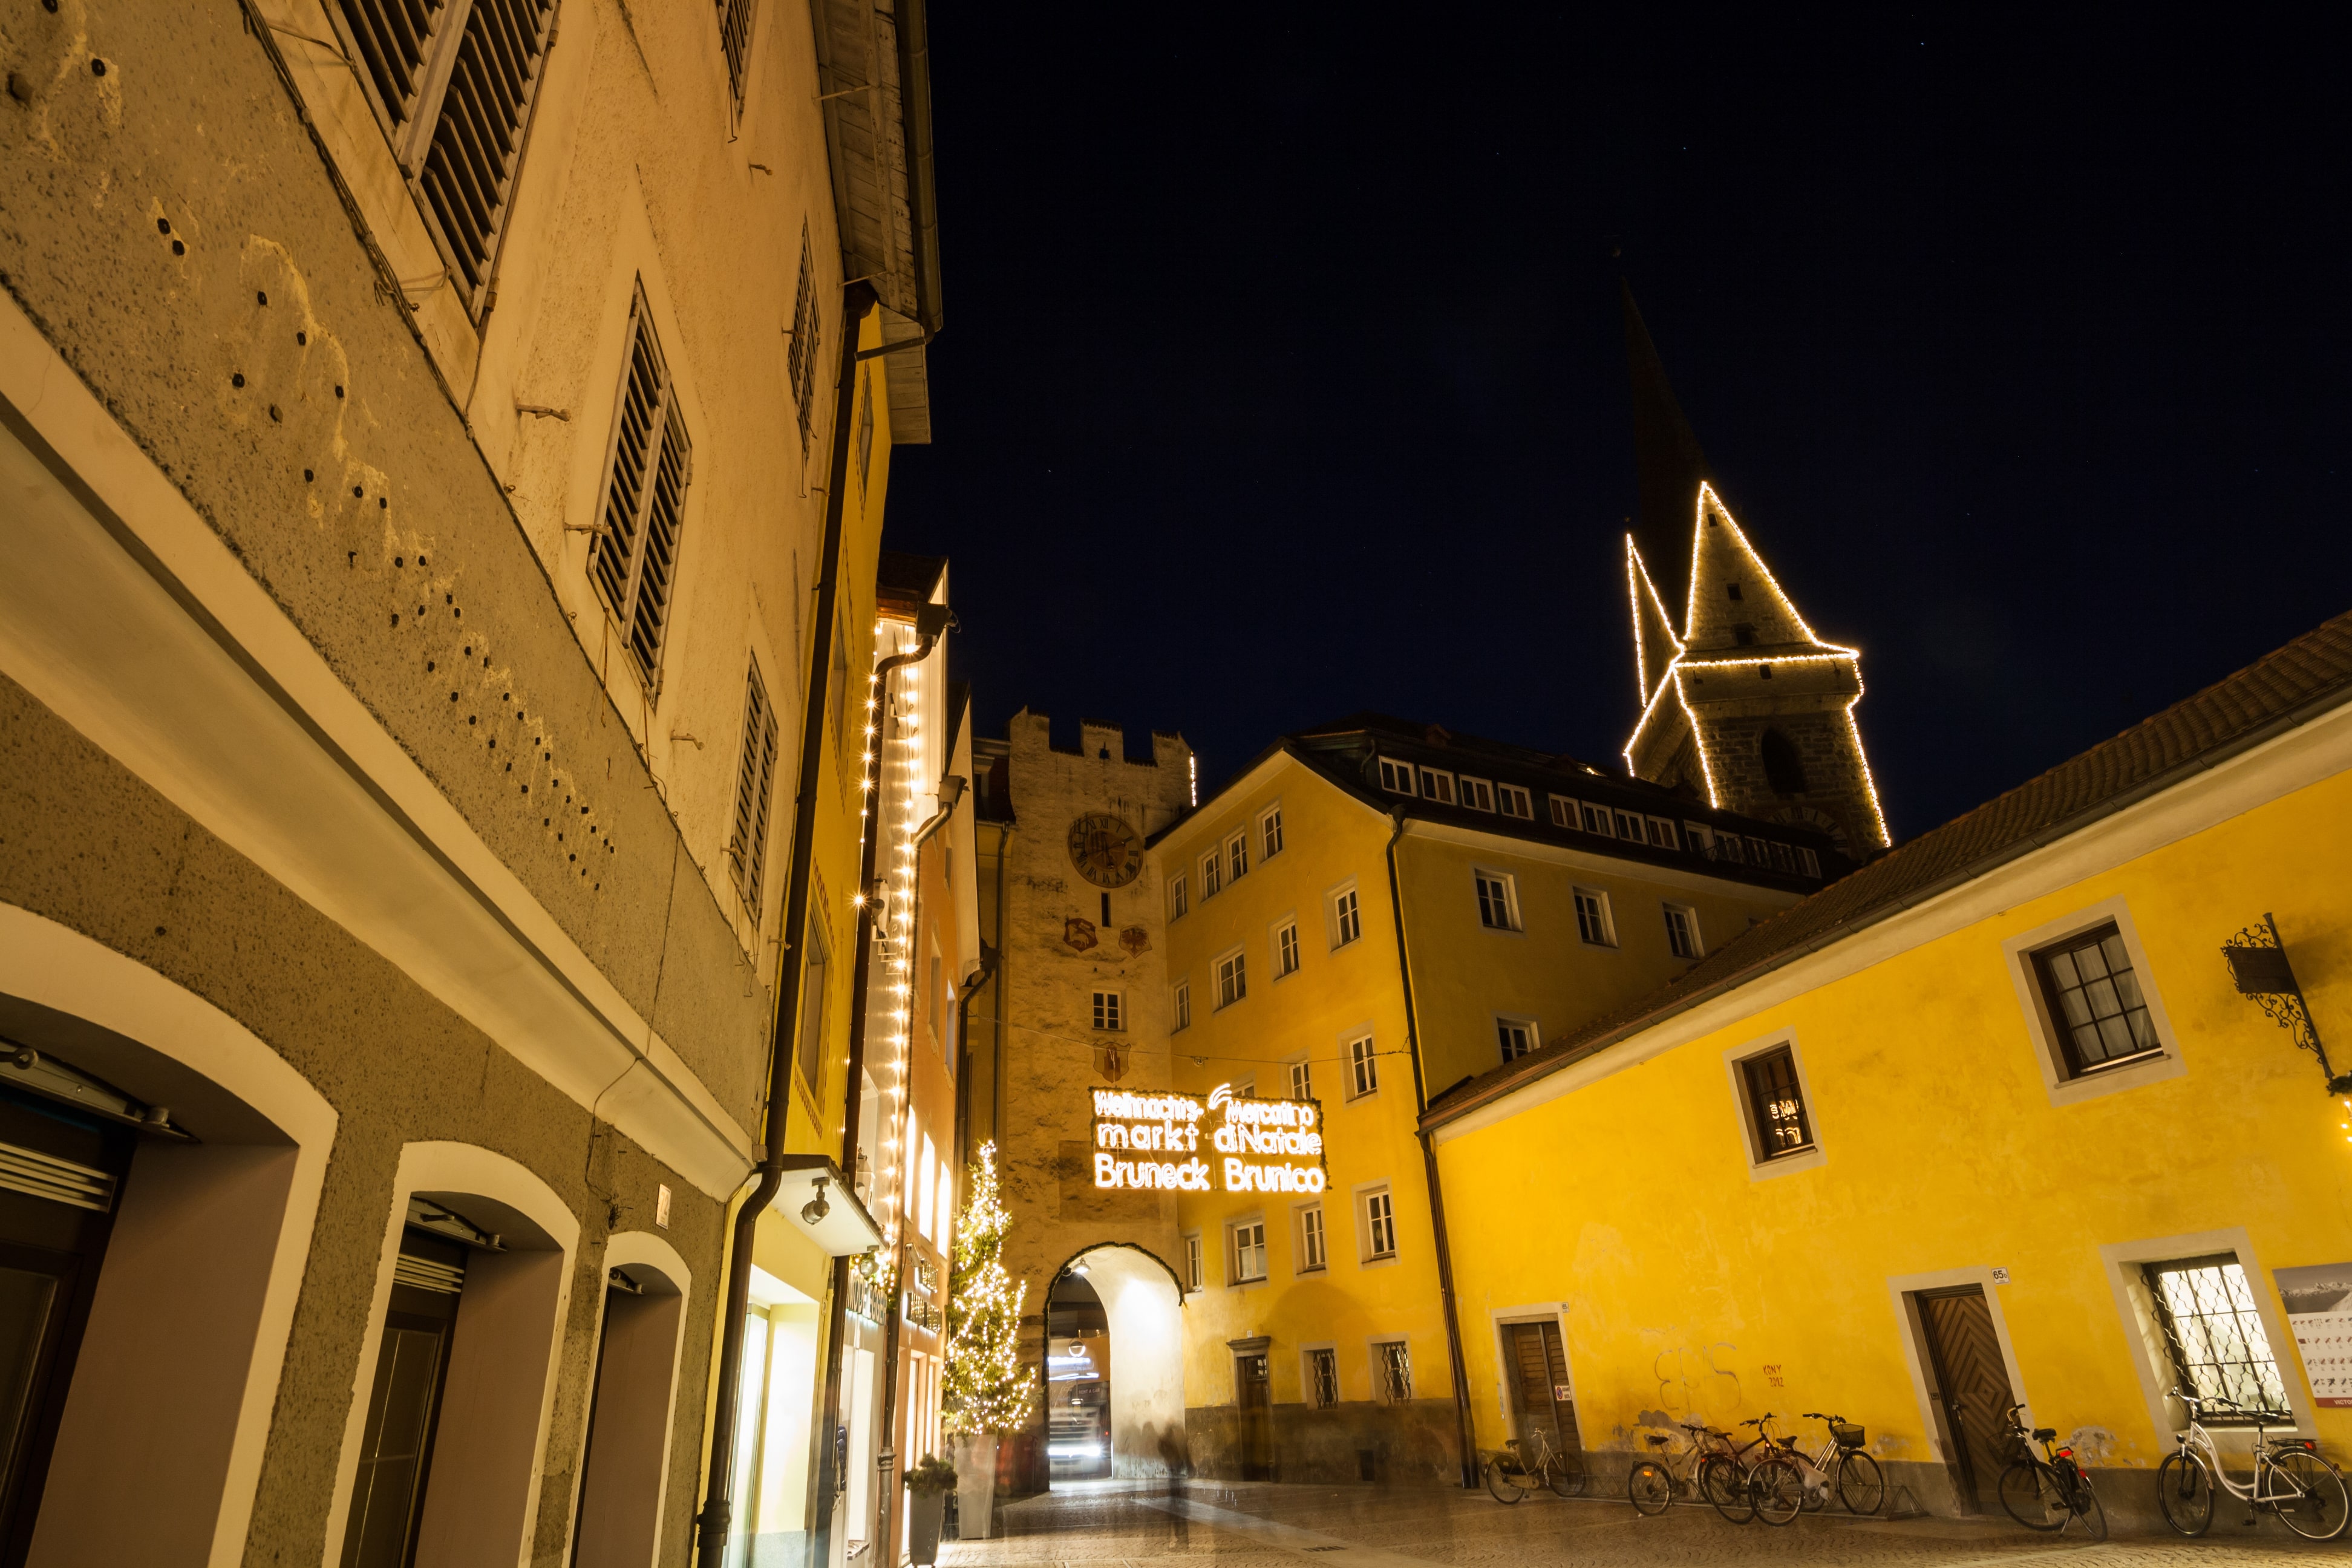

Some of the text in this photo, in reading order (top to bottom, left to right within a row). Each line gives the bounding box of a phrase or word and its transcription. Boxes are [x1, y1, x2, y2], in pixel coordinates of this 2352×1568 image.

[1094, 1090, 1204, 1122] Weihnachts-
[1226, 1100, 1315, 1126] Mercatino
[1098, 1119, 1199, 1151] markt
[1094, 1153, 1210, 1191] Bruneck
[1224, 1158, 1325, 1192] Brunico
[1762, 1365, 1782, 1376] KONY
[1768, 1377, 1784, 1387] 2012
